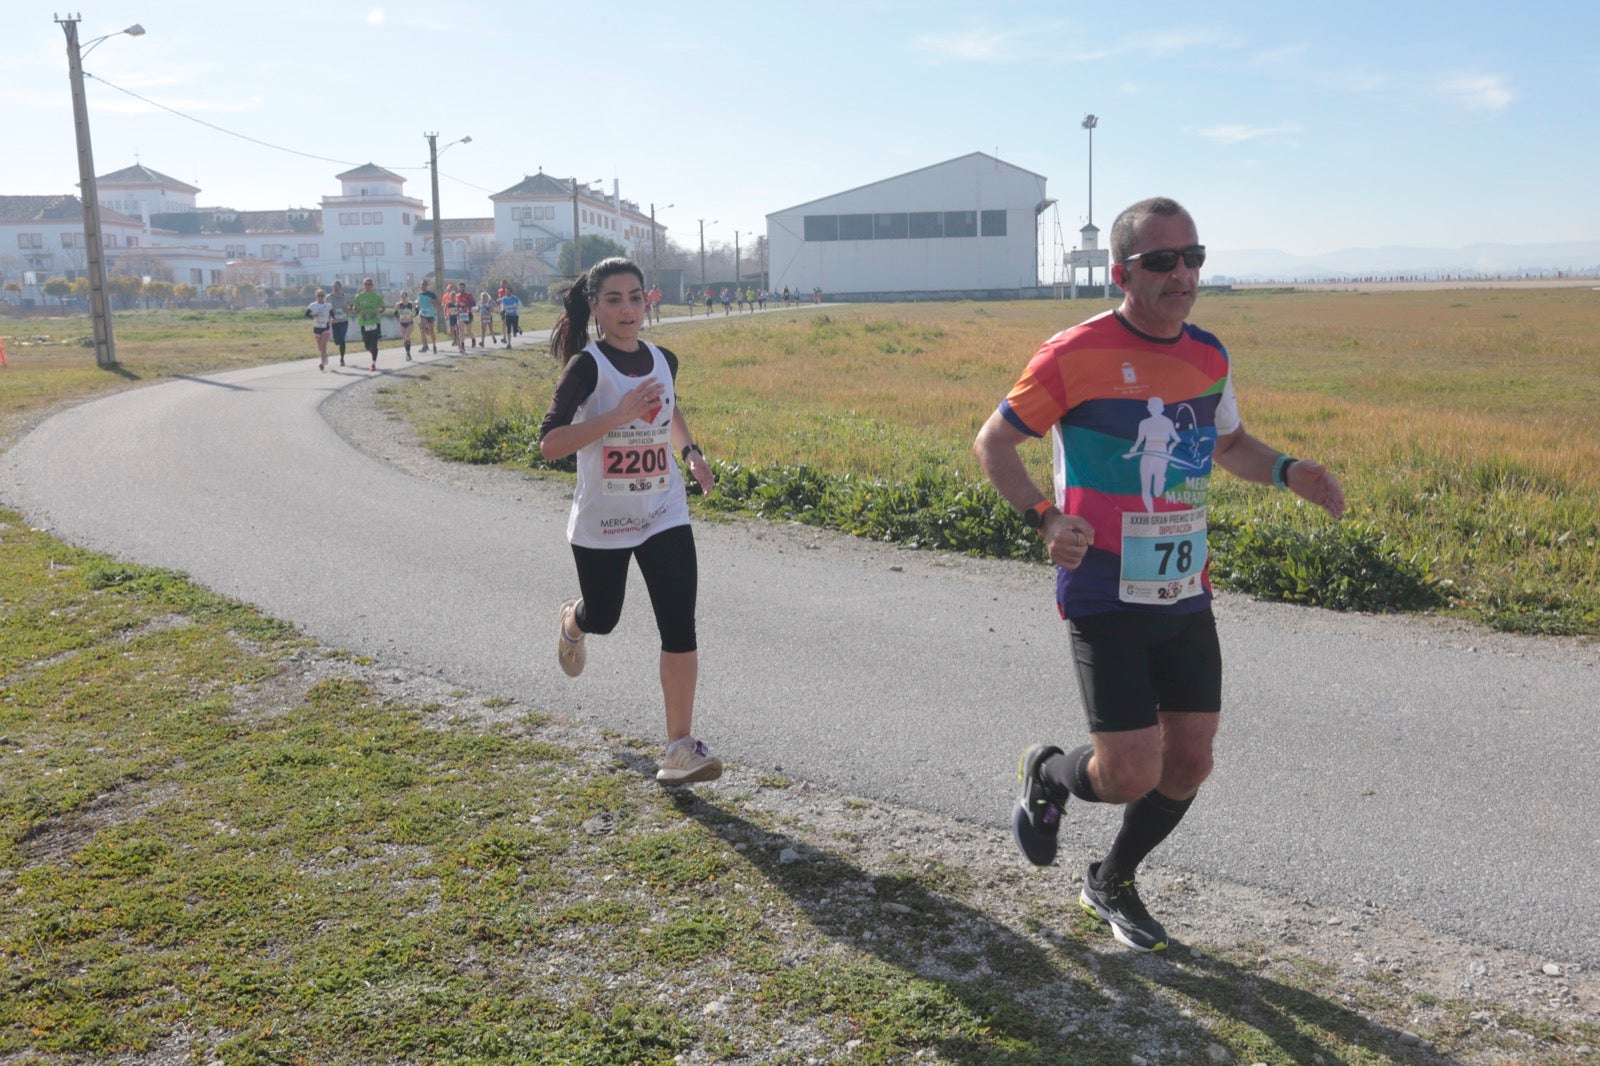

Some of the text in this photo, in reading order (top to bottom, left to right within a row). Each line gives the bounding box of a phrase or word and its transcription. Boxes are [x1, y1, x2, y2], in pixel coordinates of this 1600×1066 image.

[607, 448, 667, 473] 2200
[1151, 515, 1167, 525] GRAN
[1154, 539, 1193, 576] 78
